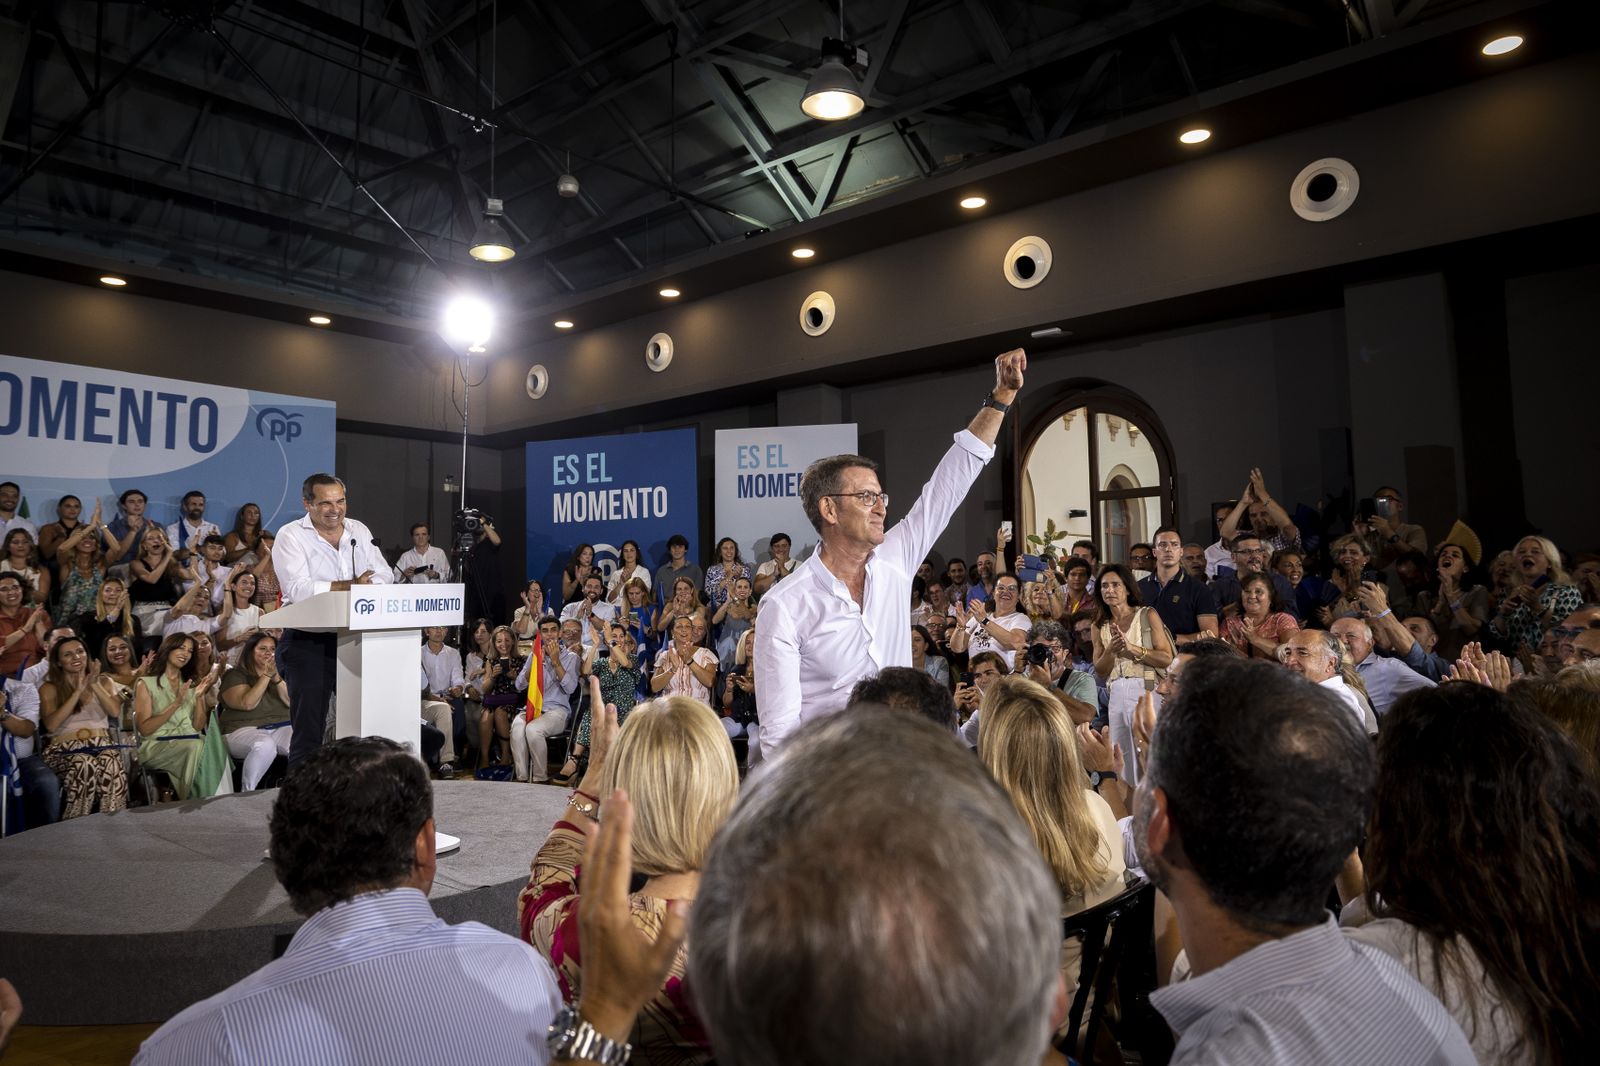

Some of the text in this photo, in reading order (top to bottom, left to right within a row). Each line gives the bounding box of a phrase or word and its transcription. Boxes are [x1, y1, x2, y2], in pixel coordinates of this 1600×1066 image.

[0, 371, 219, 454] OMENTO
[553, 452, 612, 485] ES EL
[737, 444, 788, 469] ES EL
[553, 486, 668, 524] MOMENTO
[387, 598, 460, 613] ES EL MOMENTO
